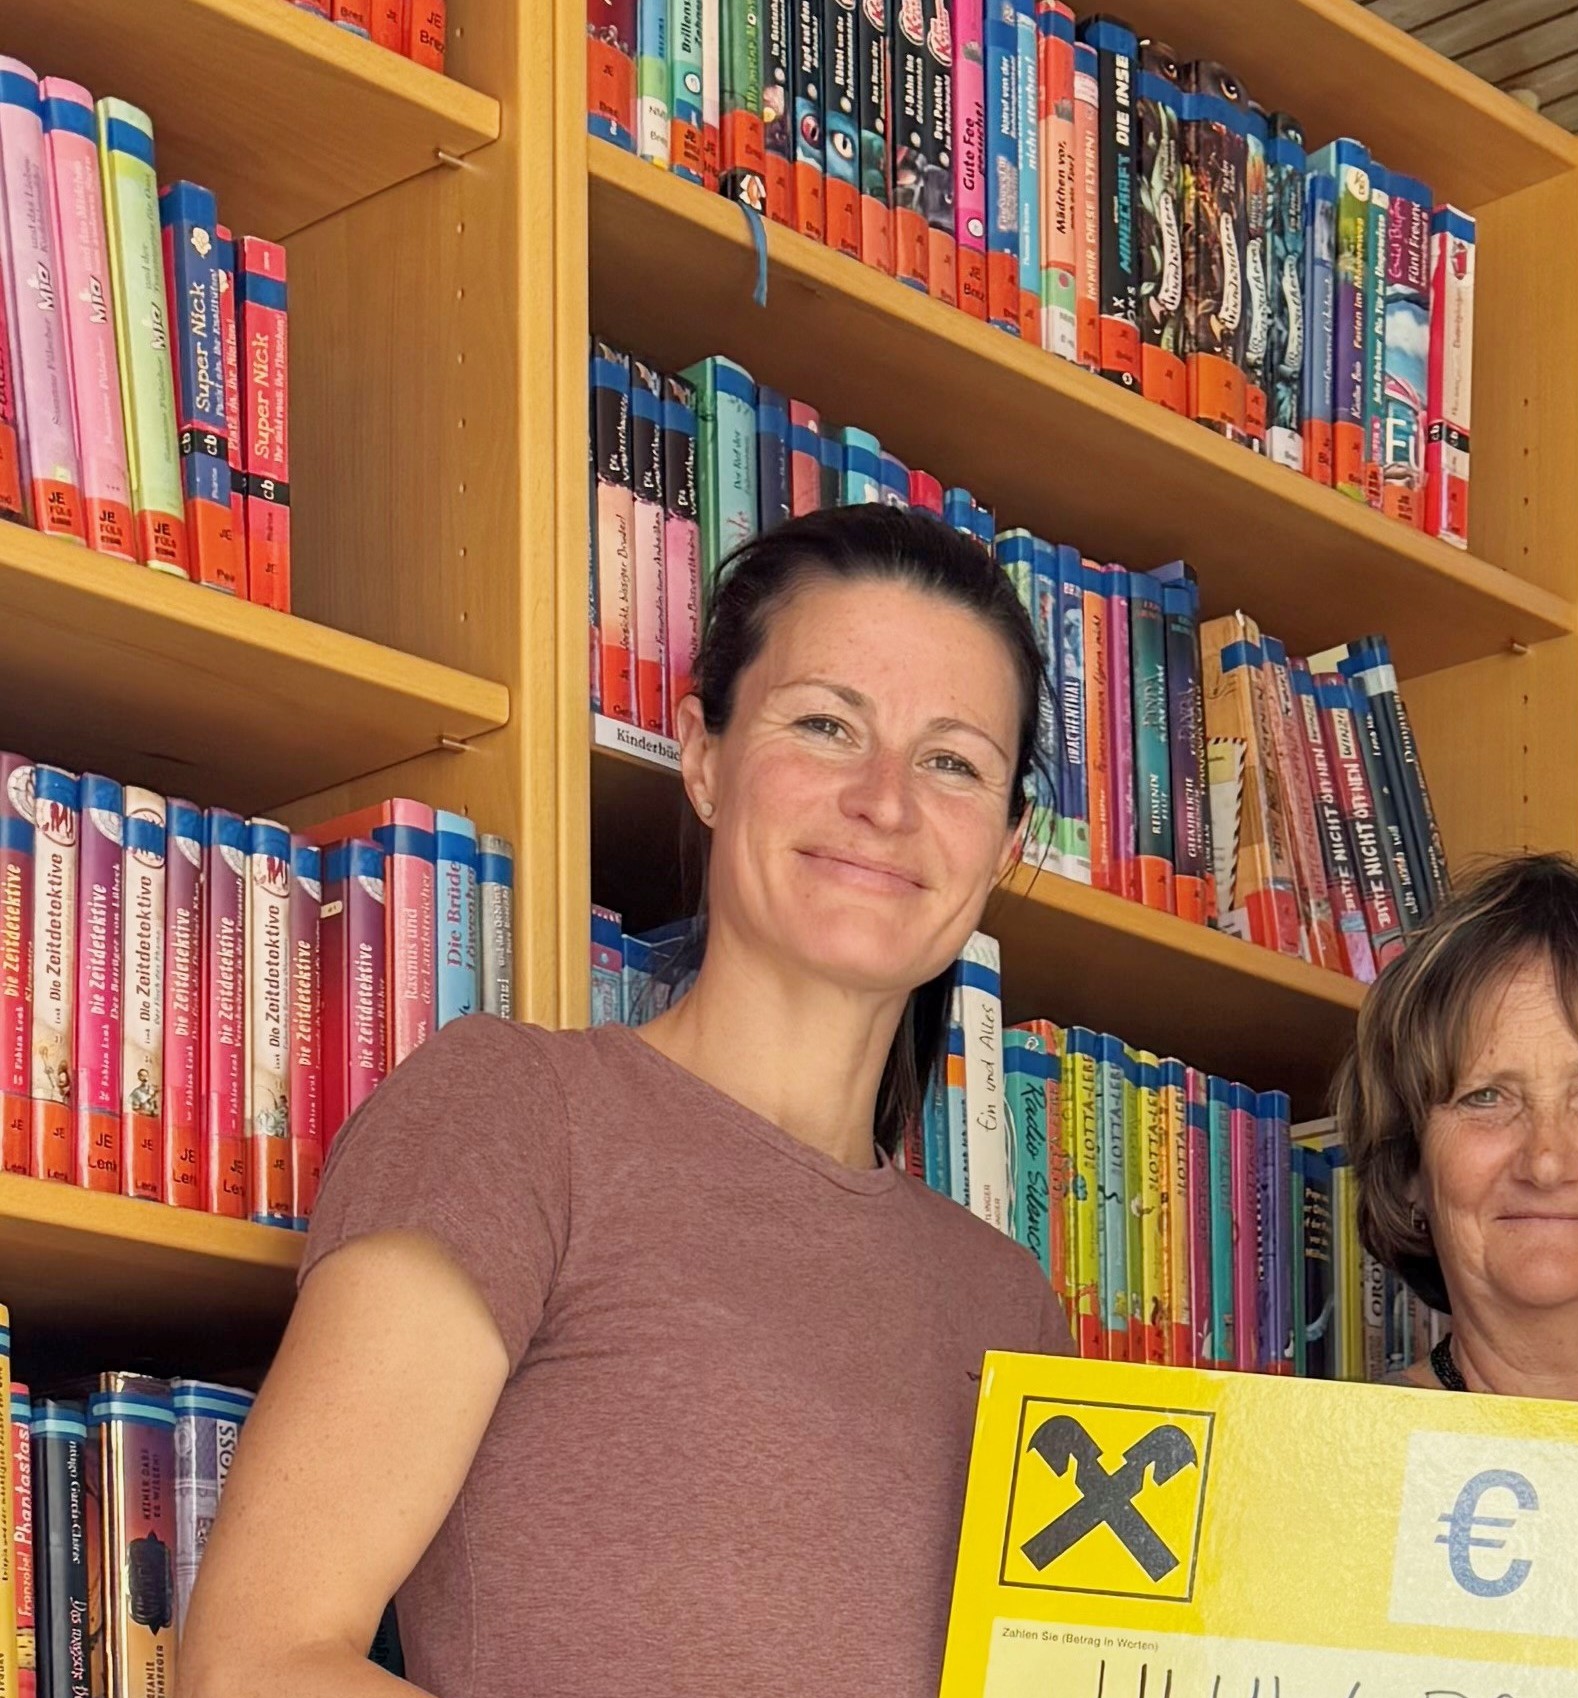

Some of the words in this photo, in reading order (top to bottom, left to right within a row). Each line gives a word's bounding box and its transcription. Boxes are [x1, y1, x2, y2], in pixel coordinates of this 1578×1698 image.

[1115, 54, 1130, 107] INSE
[190, 282, 206, 337] Nick
[193, 342, 212, 413] Super
[252, 332, 269, 387] Nick
[254, 390, 272, 459] Super
[617, 728, 680, 761] Kinderbüc
[1324, 806, 1348, 861] NICHT
[1356, 821, 1384, 876] NICHT
[2, 863, 22, 972] Zeitdetektive
[46, 852, 63, 977] Zeitdetektive
[87, 883, 107, 990] Zeitdetektive
[136, 875, 152, 997] Zeitdetektive
[447, 862, 461, 924] Brüde
[465, 867, 477, 971] Löwenher
[173, 907, 191, 1013] Zeitdetektive
[217, 916, 235, 1021] Zeitdetektive
[266, 904, 281, 1024] Zeitdetektive
[295, 940, 312, 1042] Zeitdetektive
[356, 942, 375, 1045] Zeitdetektive
[447, 930, 461, 967] Die
[498, 978, 509, 1019] ranzl
[978, 1003, 996, 1047] Alles
[976, 1104, 997, 1132] Ein
[979, 1059, 996, 1092] und
[1083, 1056, 1095, 1161] LOTTA-LEBE
[1111, 1064, 1122, 1168] LOTTA-LEBE
[1148, 1090, 1159, 1183] LOTTA-LEB
[1176, 1088, 1186, 1189] LOTTA-LEBE
[1025, 1170, 1048, 1260] Silenc
[1435, 1468, 1541, 1600] €
[1002, 1627, 1038, 1641] Zahlen
[1042, 1630, 1058, 1643] Sie
[1062, 1632, 1101, 1648] (Betrag
[1104, 1637, 1113, 1647] in
